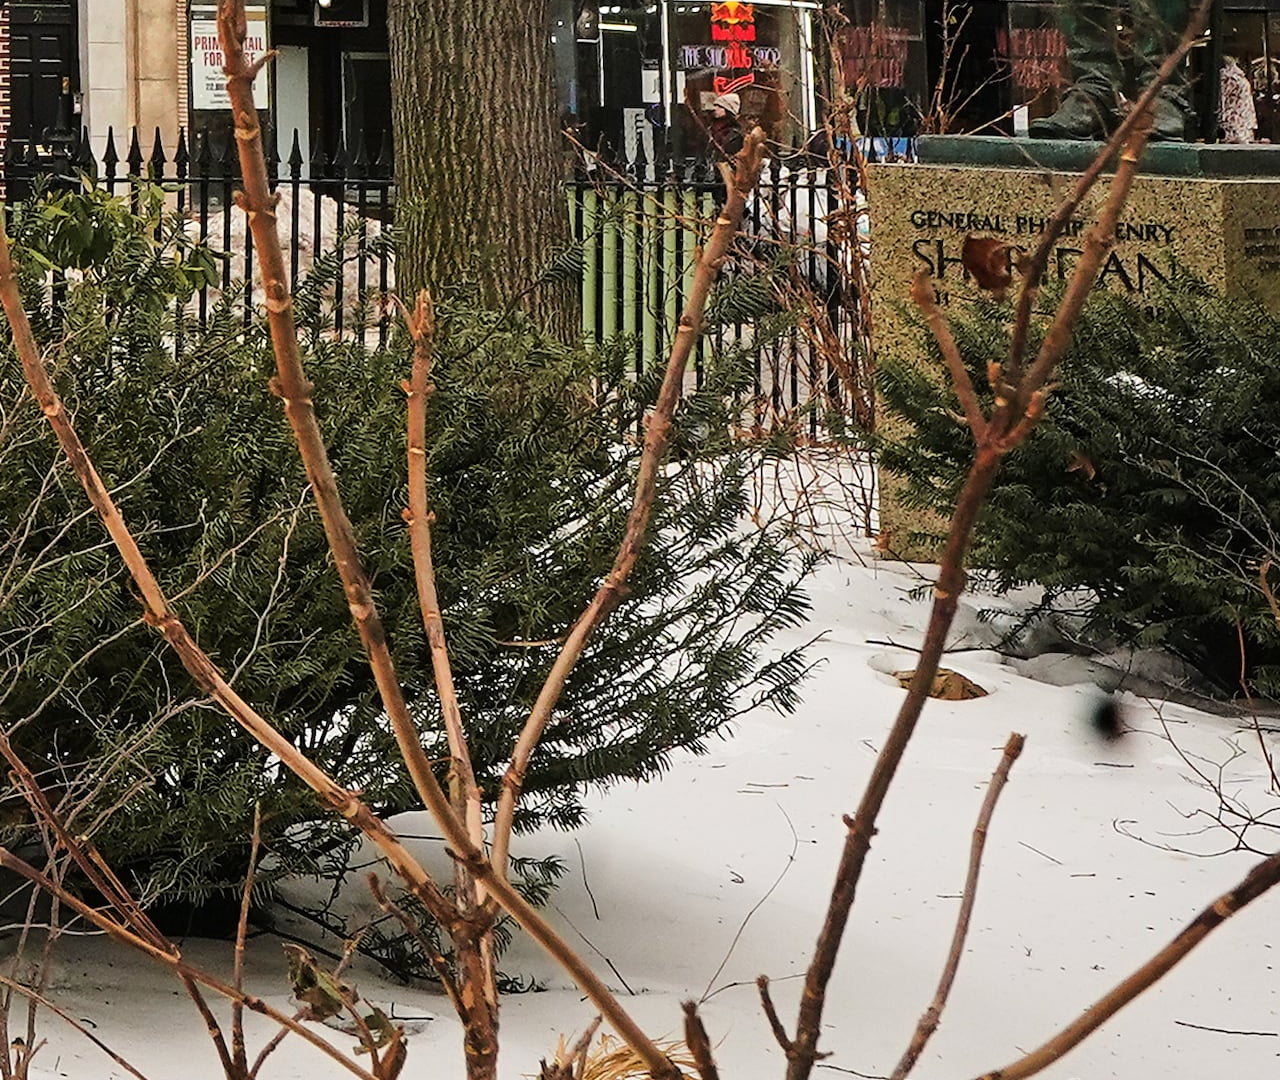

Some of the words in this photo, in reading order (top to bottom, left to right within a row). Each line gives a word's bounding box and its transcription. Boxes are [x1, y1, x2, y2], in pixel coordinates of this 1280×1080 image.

[204, 51, 223, 67] FOR
[910, 210, 1007, 234] GENERAL
[1115, 222, 1177, 245] ENRY
